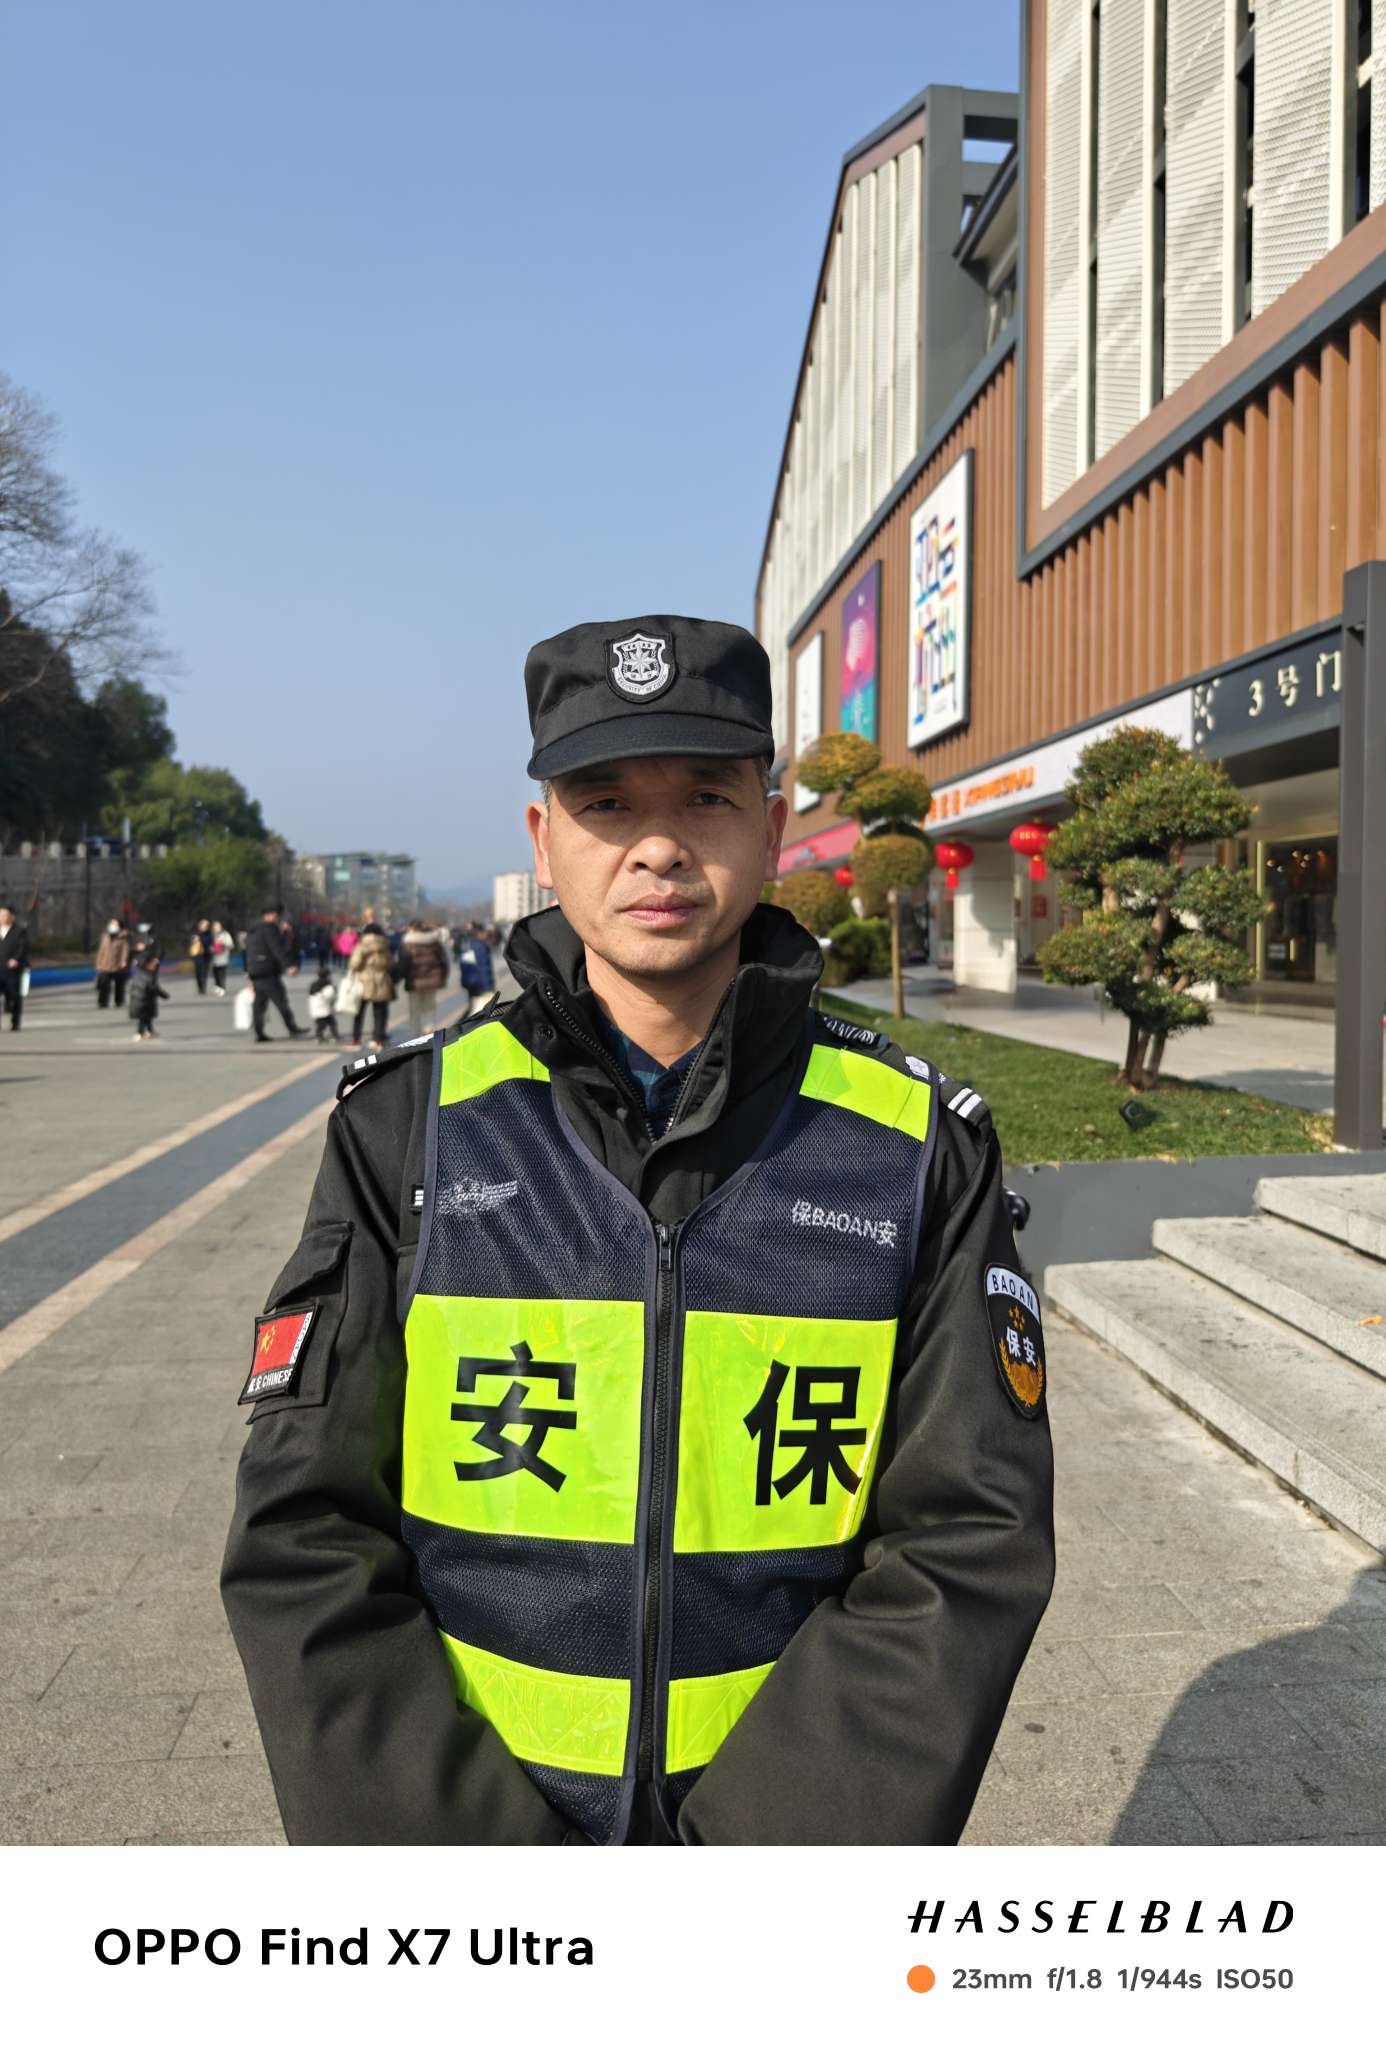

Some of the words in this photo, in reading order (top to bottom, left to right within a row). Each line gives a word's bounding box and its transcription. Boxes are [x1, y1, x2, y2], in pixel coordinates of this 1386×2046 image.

[1248, 650, 1342, 717] 3号门
[992, 1274, 1034, 1311] BAOAN
[1006, 1325, 1037, 1367] 保安
[450, 1340, 578, 1492] 安
[742, 1359, 867, 1506] 保
